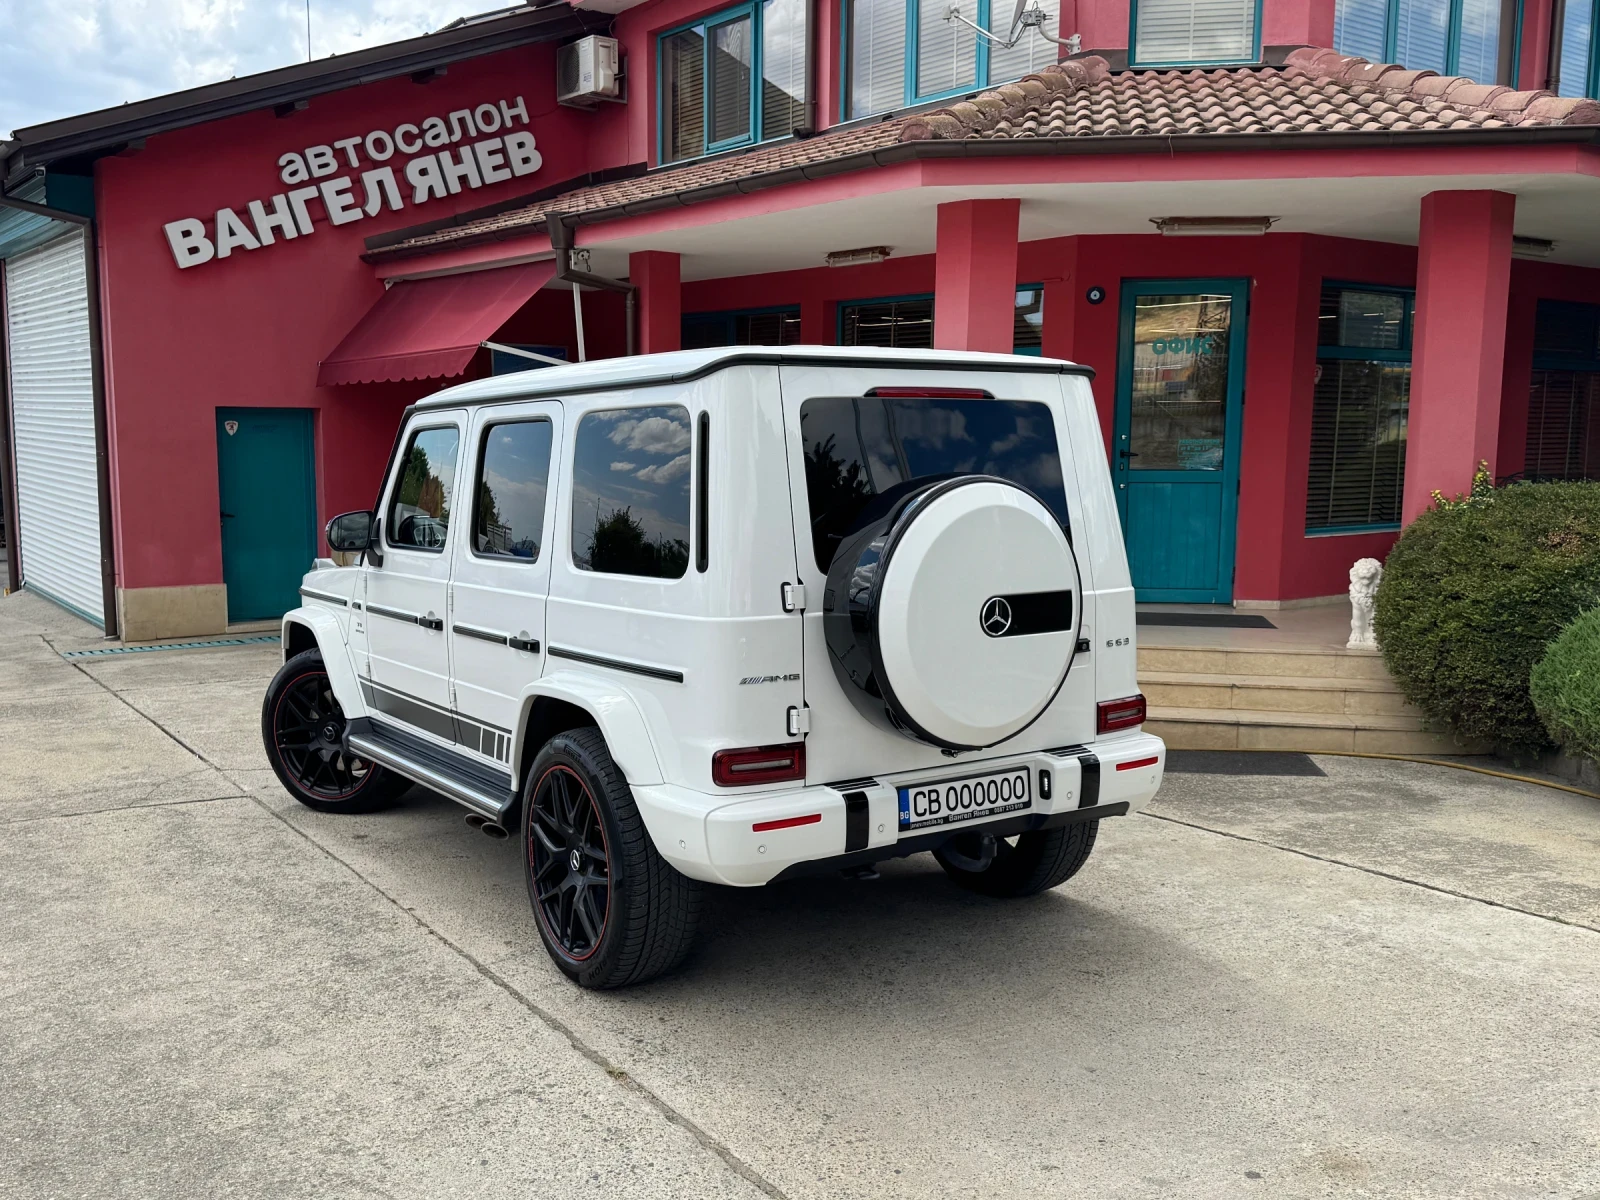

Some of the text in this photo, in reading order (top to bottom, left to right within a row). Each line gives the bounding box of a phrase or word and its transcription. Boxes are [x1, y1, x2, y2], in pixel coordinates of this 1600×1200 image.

[278, 96, 530, 185] автосалон
[163, 131, 543, 269] ВАНГЕЛ ЯНЕВ
[1152, 336, 1214, 355] ОФИС
[900, 811, 910, 819] BG
